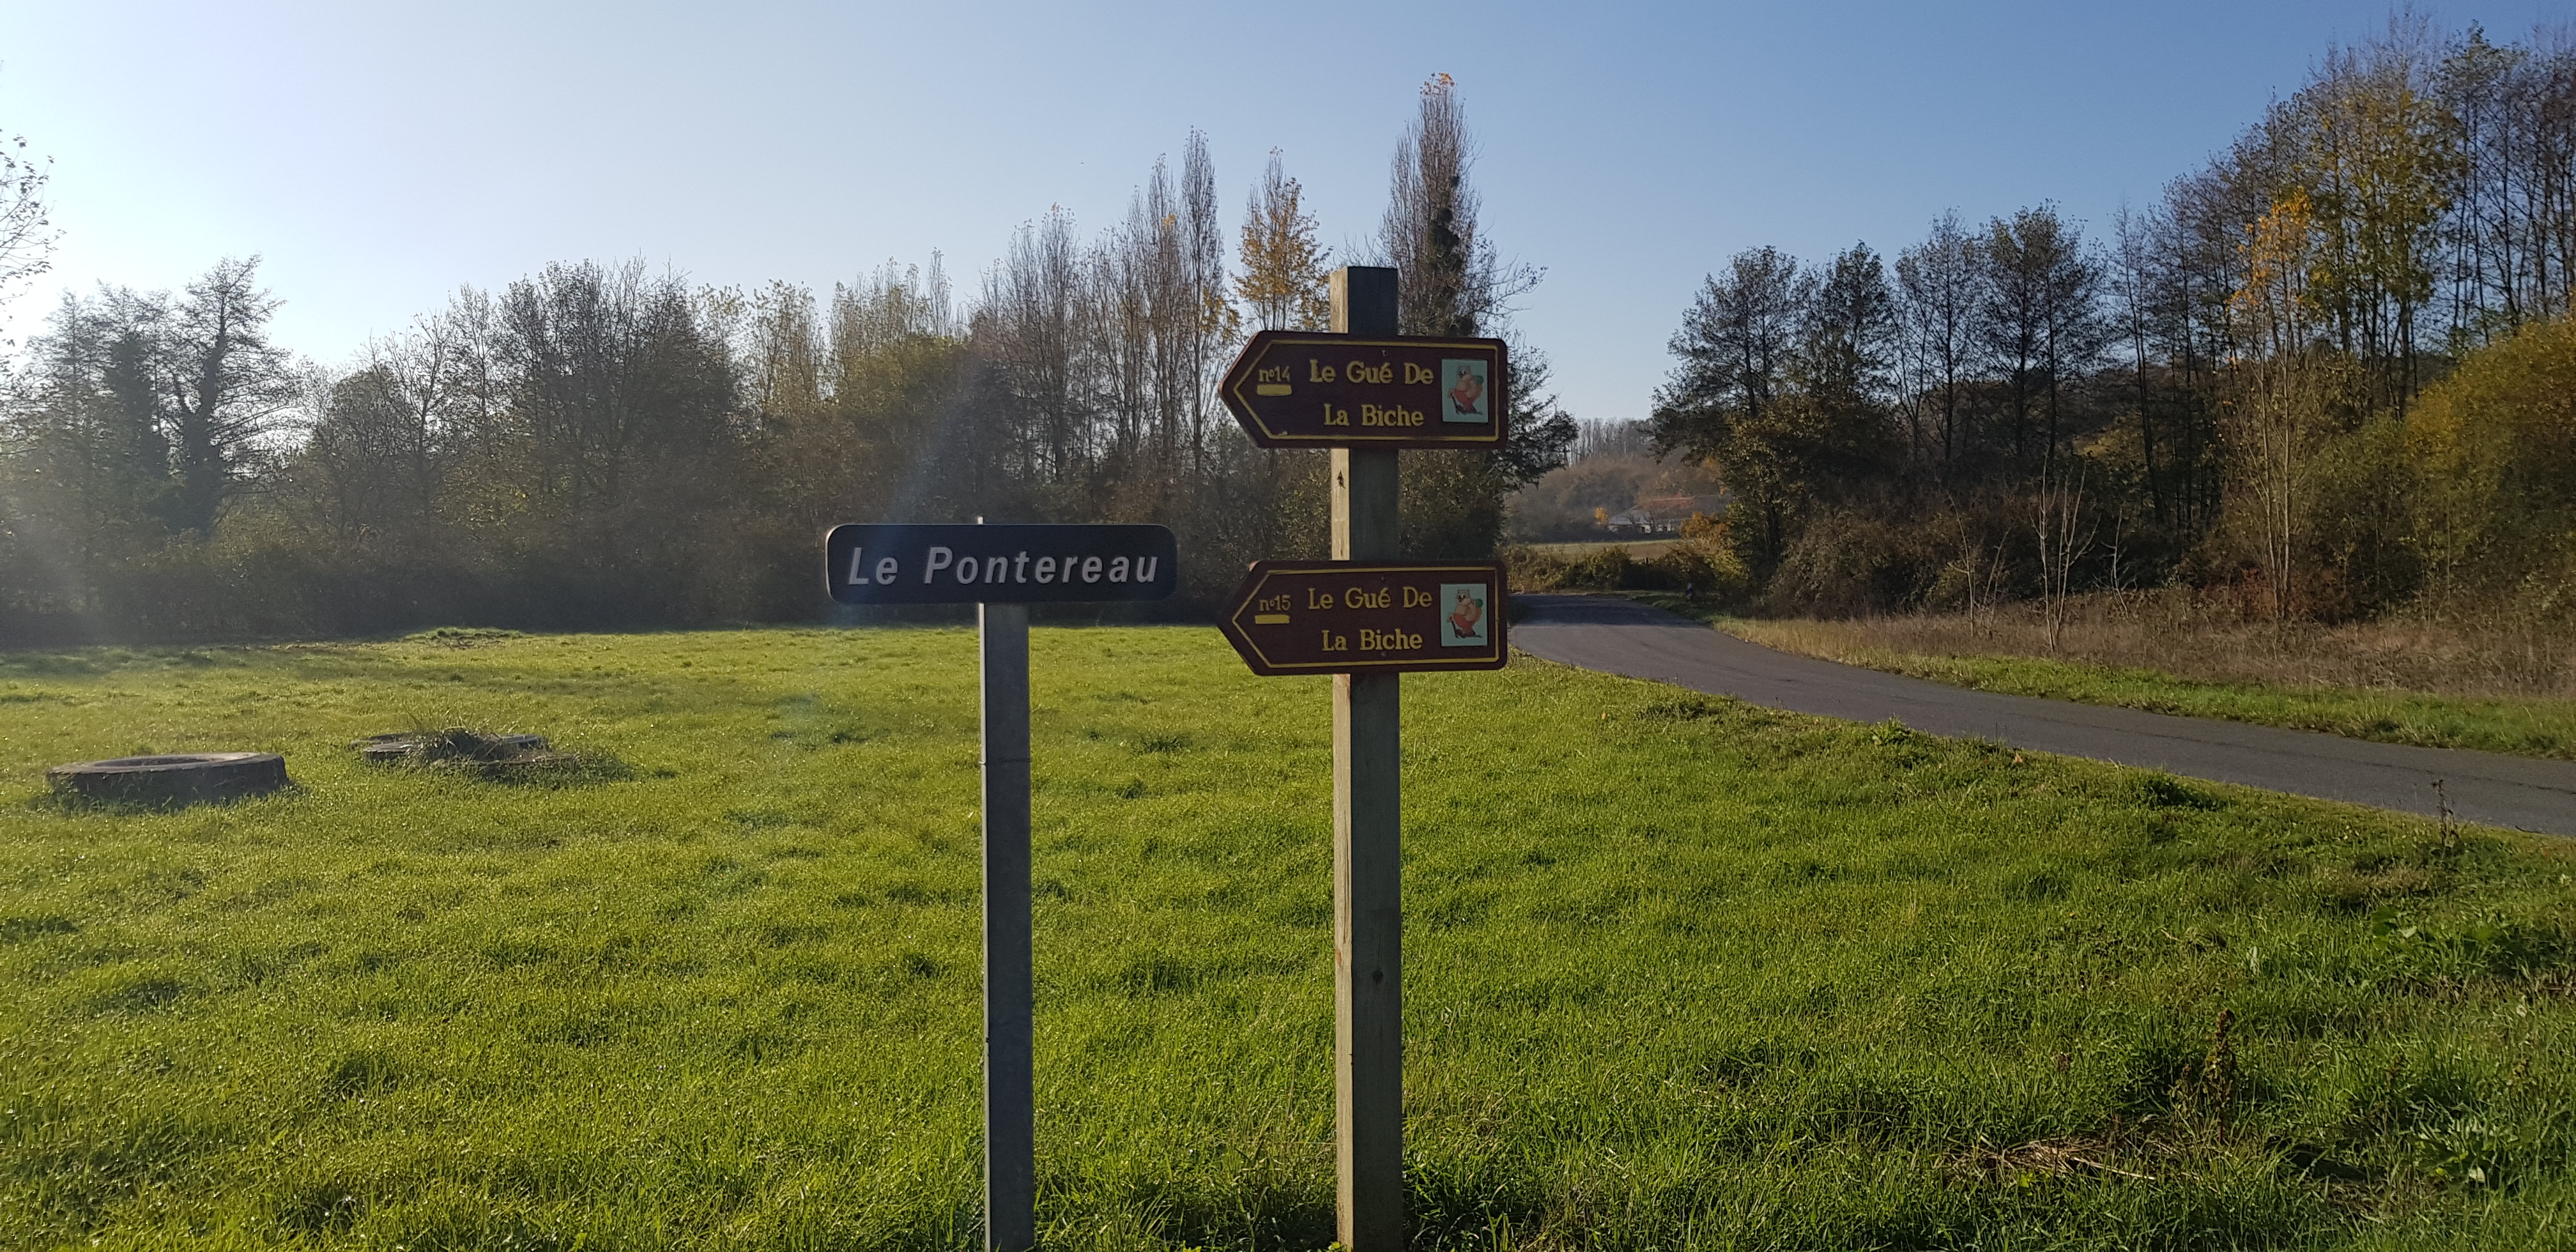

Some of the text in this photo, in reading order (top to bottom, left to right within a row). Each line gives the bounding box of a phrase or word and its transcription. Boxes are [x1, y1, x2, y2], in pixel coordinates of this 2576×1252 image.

[1309, 359, 1434, 385] Le Gué De
[1324, 404, 1425, 427] La Biche
[848, 546, 1158, 585] Le Pontereau
[1308, 586, 1432, 610] Le Gué De
[1322, 629, 1423, 652] La Biche
